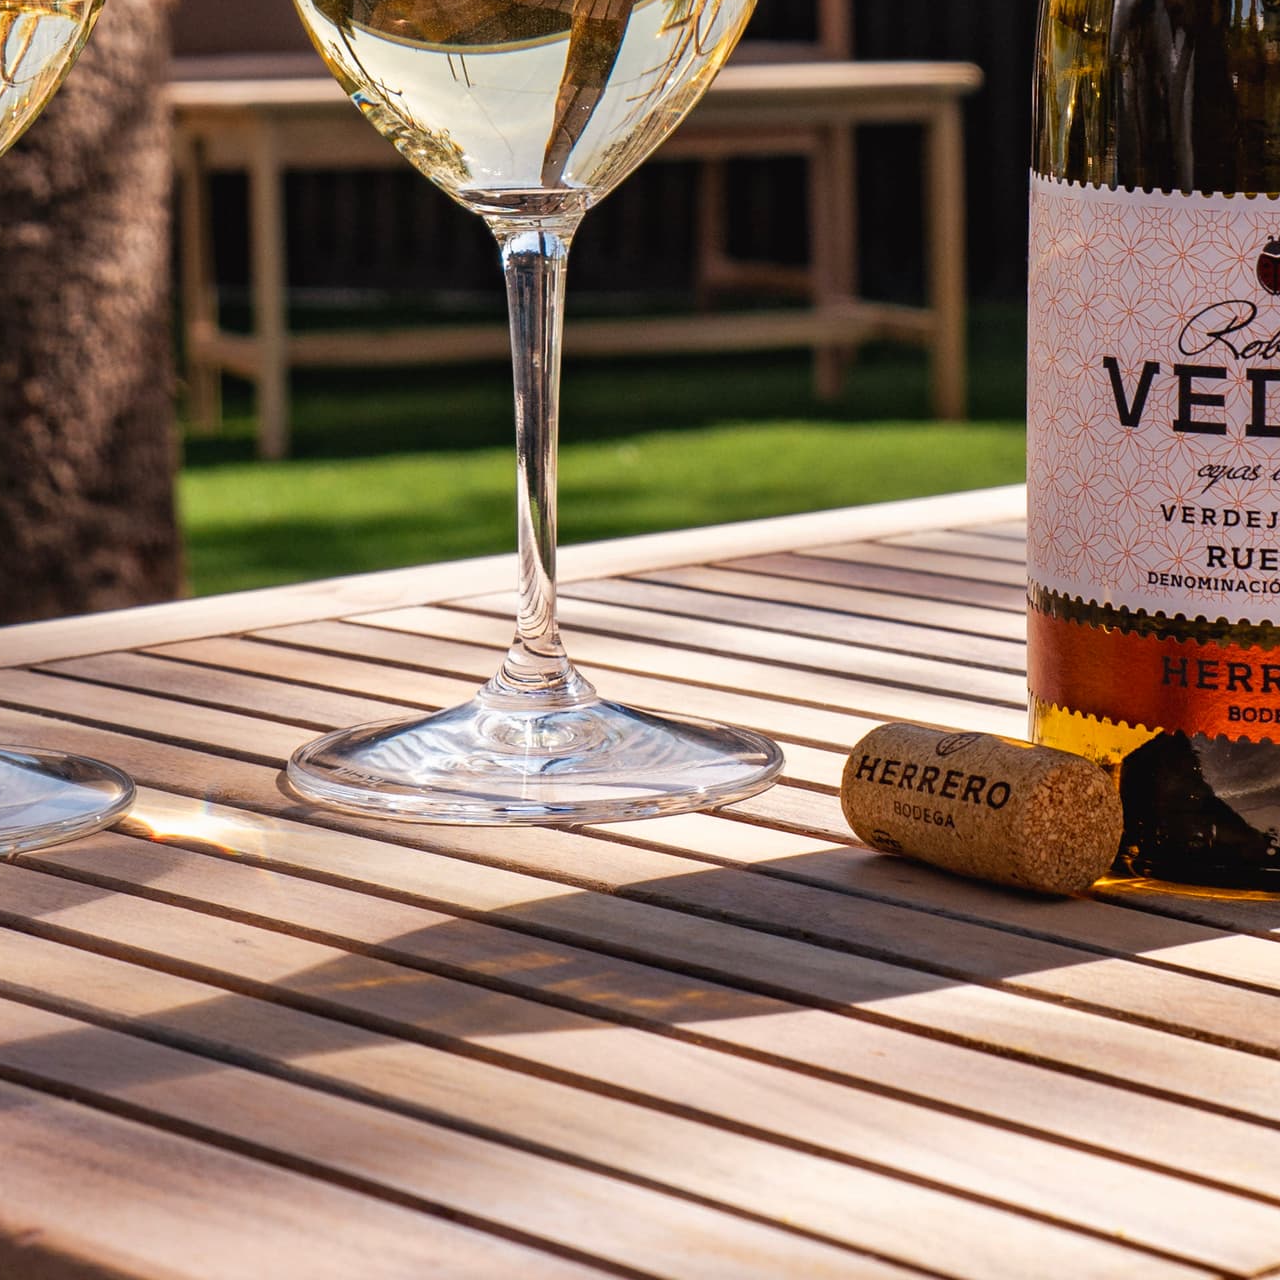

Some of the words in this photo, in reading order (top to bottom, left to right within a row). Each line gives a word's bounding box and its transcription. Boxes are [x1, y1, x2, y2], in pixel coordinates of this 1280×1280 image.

[1197, 463, 1262, 495] cepas
[854, 755, 1012, 810] HERRERO
[893, 801, 956, 829] BODEGA
